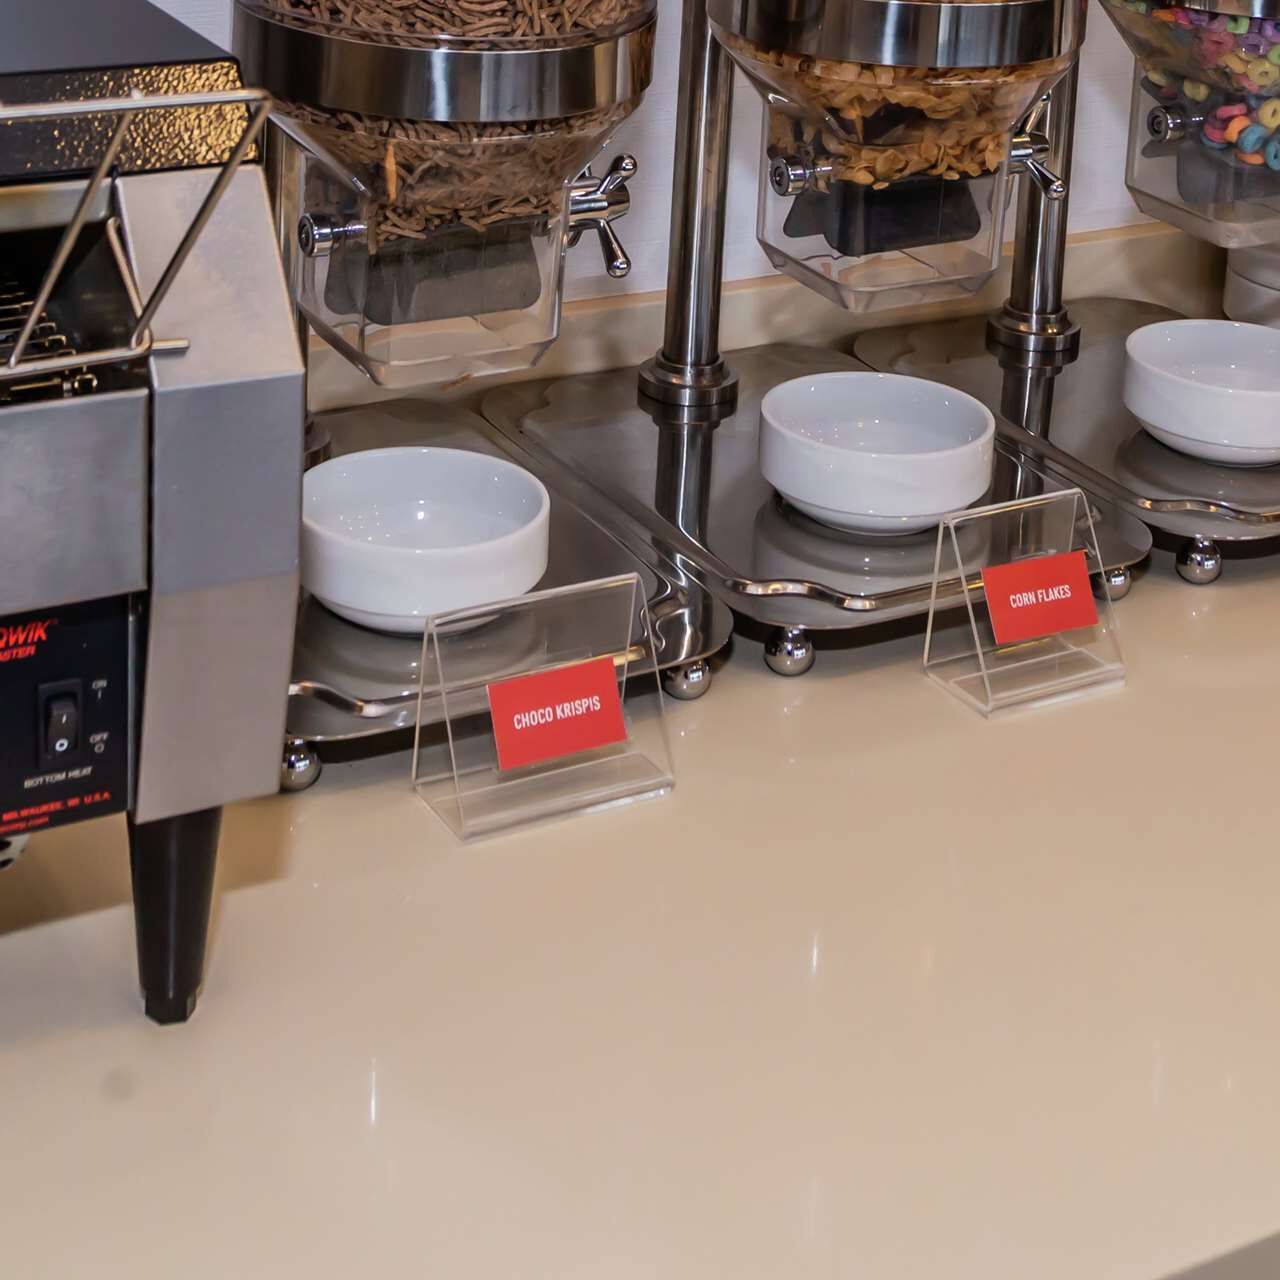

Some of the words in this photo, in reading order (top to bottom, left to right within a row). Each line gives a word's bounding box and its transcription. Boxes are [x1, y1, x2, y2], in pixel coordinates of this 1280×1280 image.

[1009, 592, 1037, 609] CORN
[1037, 584, 1072, 603] FLAKES
[91, 679, 108, 691] ON
[513, 706, 554, 730] CHOCO
[555, 695, 601, 720] KRISPIS
[89, 731, 110, 745] OFF
[23, 770, 67, 790] BOTTOM
[67, 765, 94, 781] HEAT
